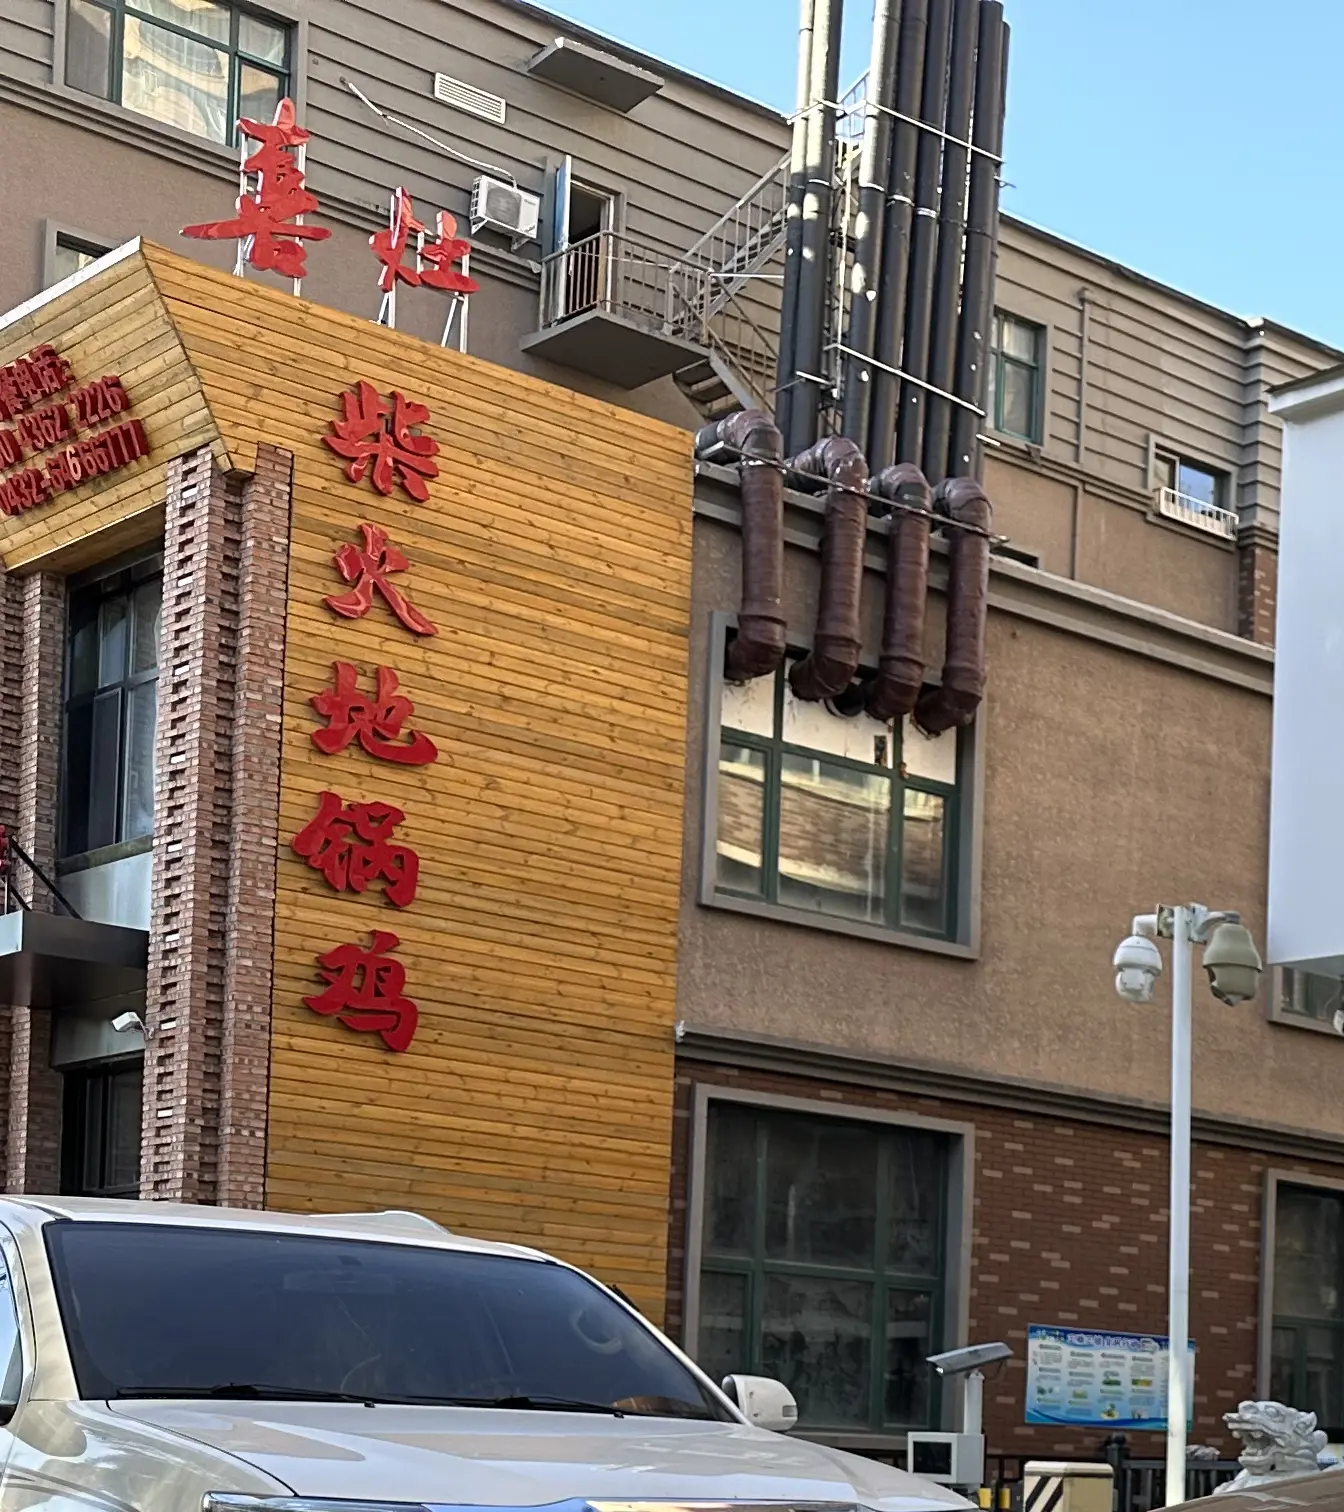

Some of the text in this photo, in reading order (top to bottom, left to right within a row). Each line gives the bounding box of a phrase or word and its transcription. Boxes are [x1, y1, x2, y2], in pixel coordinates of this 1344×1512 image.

[291, 379, 441, 1053] 柴火地锅鸡
